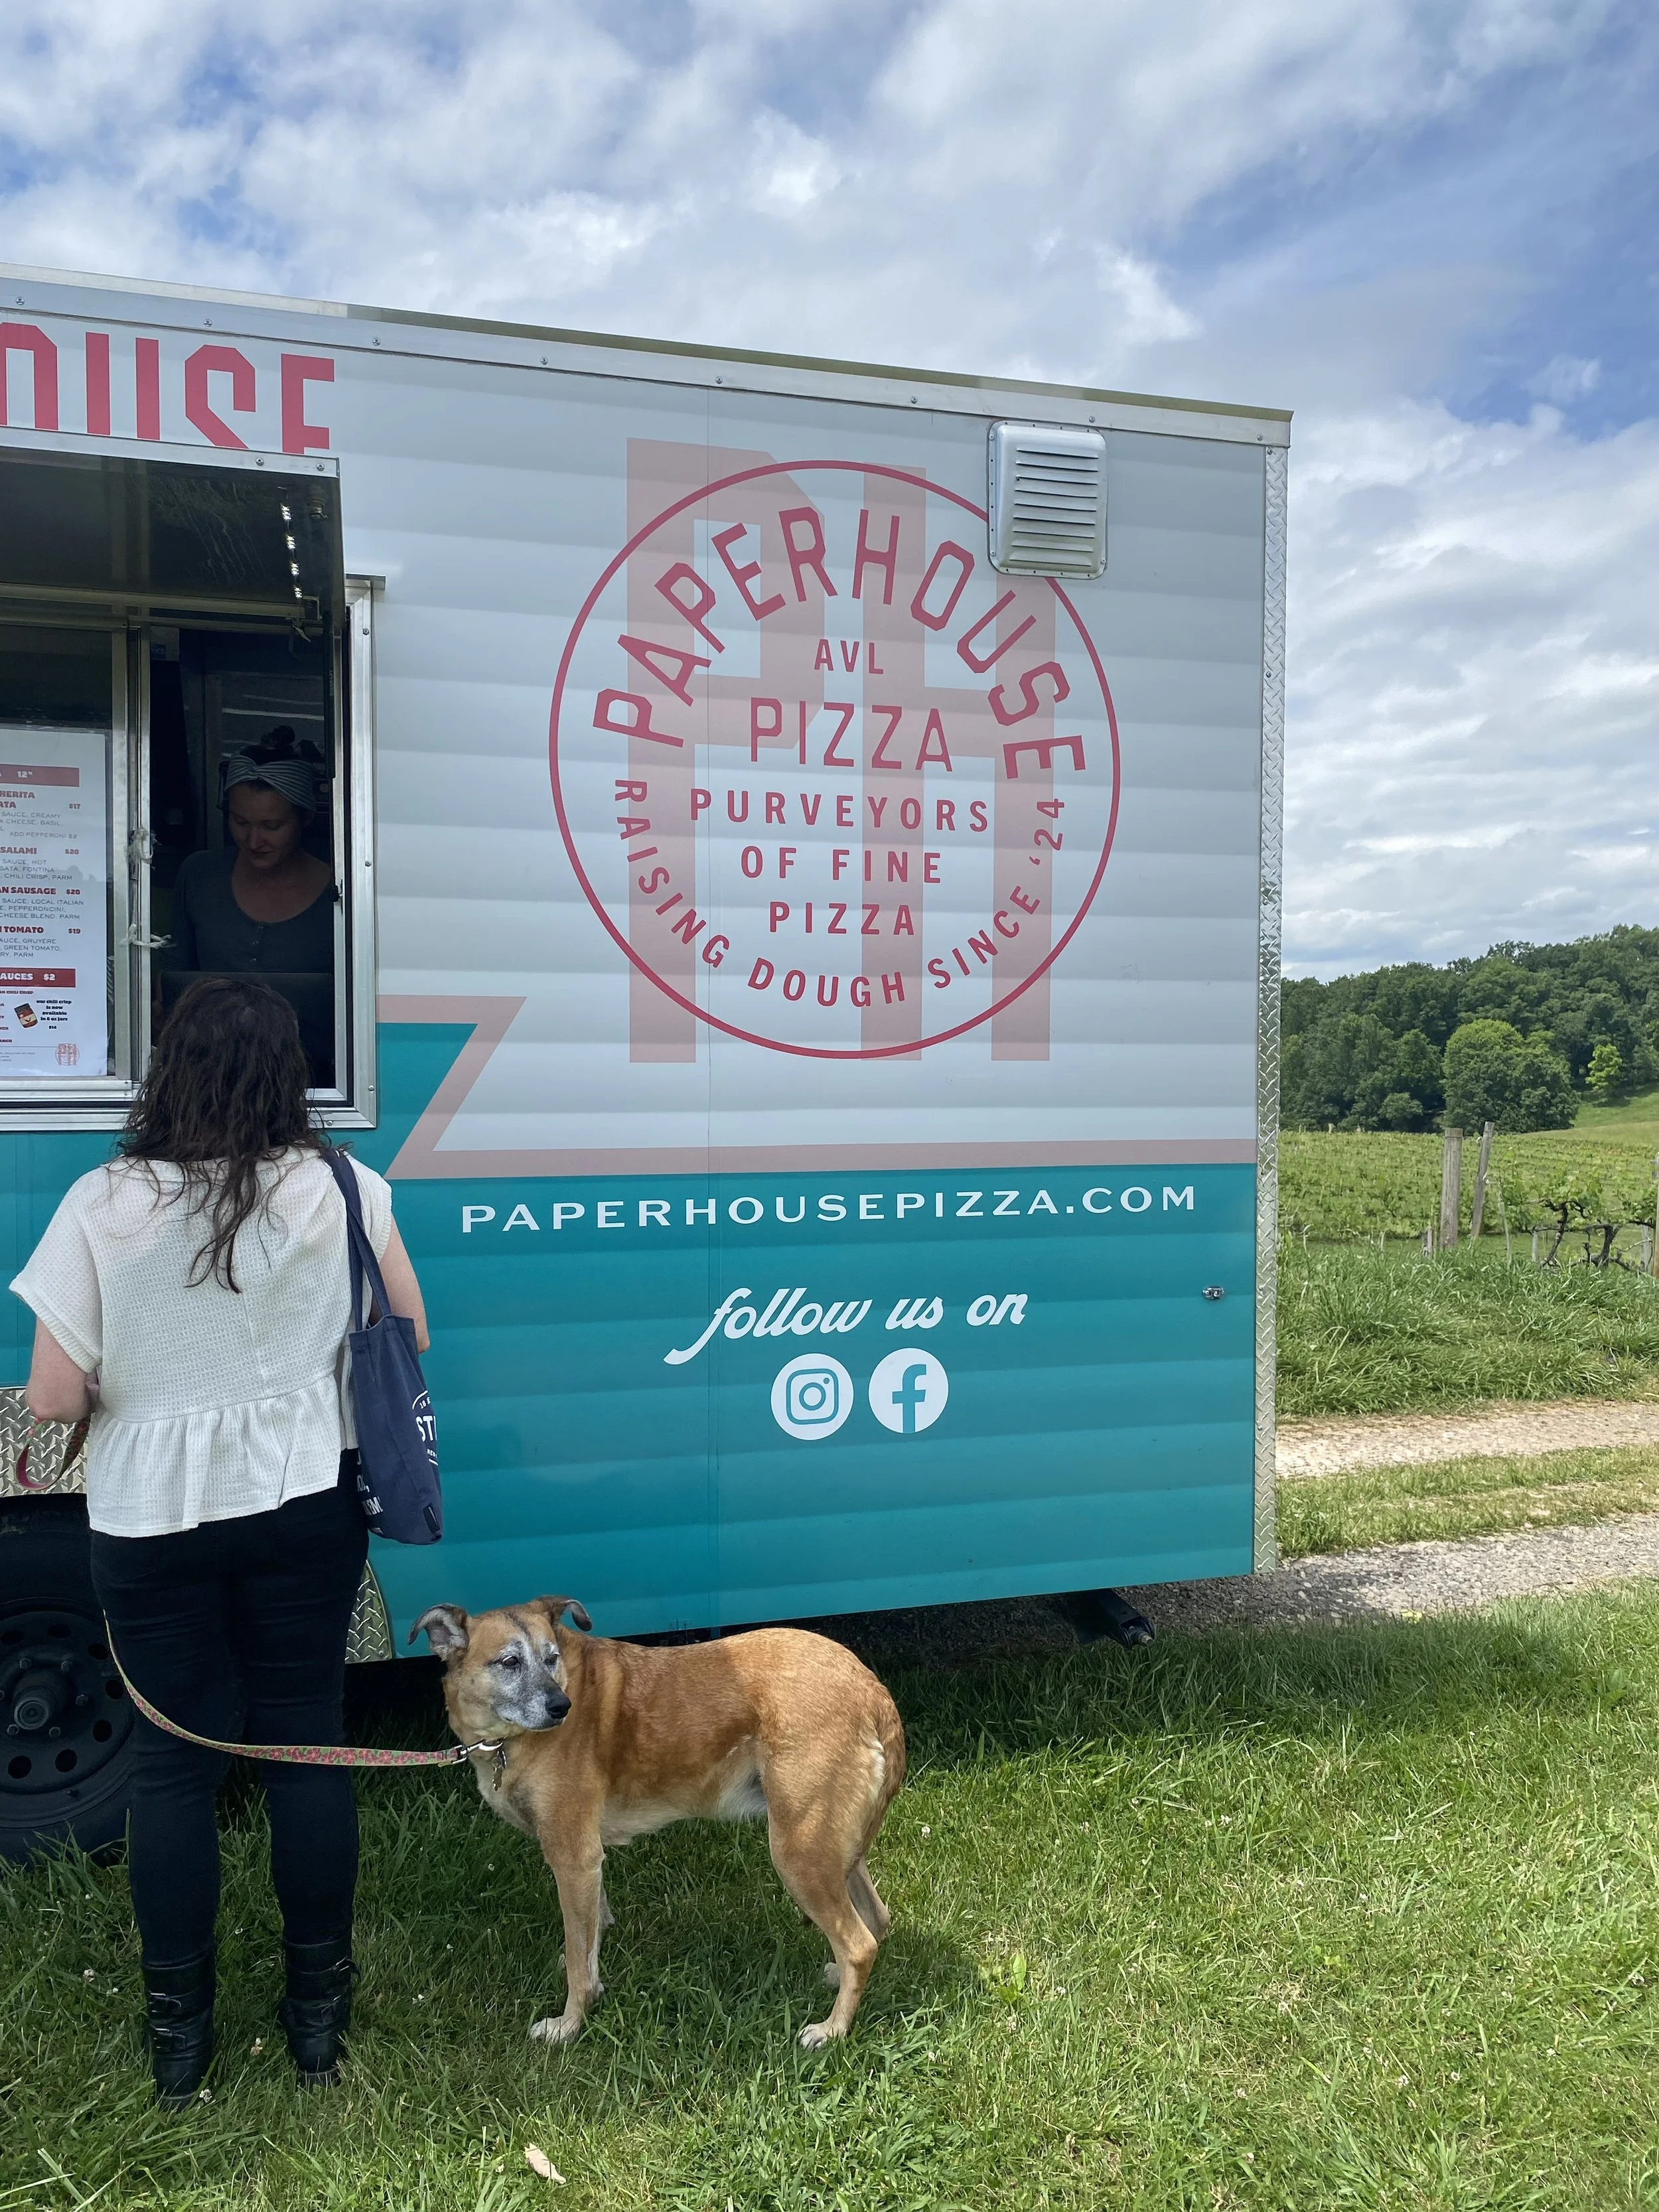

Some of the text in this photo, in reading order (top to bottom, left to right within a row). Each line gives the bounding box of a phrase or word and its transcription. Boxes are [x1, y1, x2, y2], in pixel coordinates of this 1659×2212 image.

[593, 506, 1086, 779] PAPERHOUSE
[814, 638, 884, 674] AVL
[751, 697, 952, 772] PIZZA
[691, 788, 989, 832] PURVEYORS
[741, 846, 941, 884] OF FINE
[614, 780, 731, 968] RAISING
[748, 958, 906, 1007] DOUGH
[934, 885, 1041, 990] SINCE
[770, 901, 914, 936] PIZZA
[462, 1185, 1194, 1234] PAPERHOUSEPIZZA.COM
[663, 1287, 1029, 1366] follow us on
